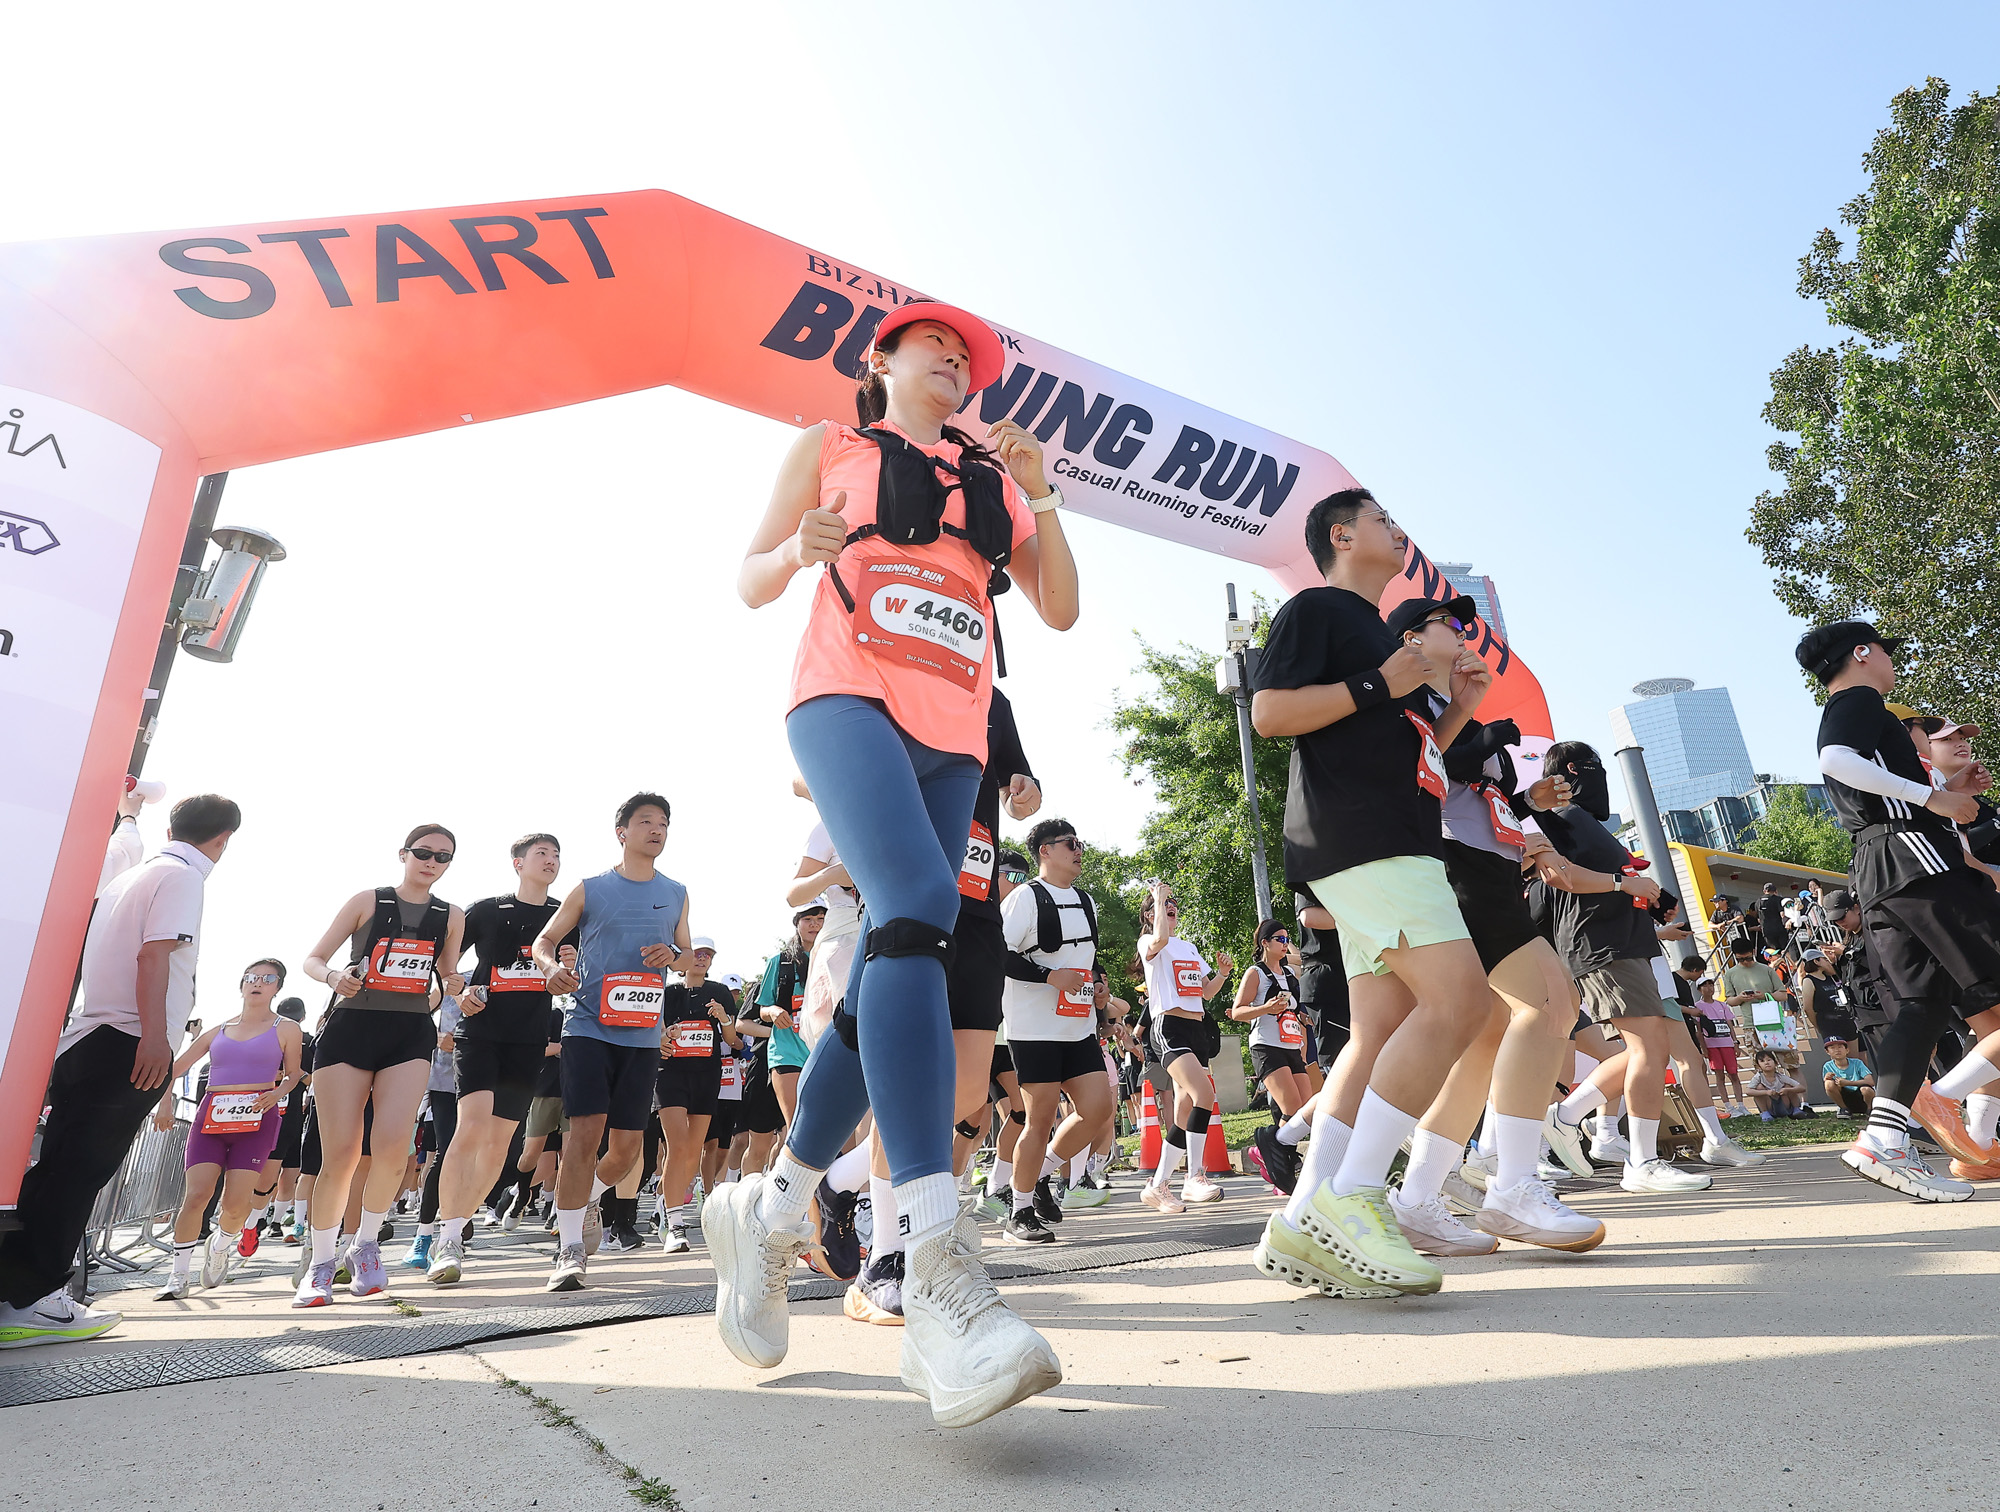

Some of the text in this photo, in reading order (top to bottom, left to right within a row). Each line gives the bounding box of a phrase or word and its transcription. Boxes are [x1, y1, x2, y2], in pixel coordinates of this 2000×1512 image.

[158, 207, 616, 319] START
[1155, 424, 1300, 518] RUN
[1053, 457, 1268, 537] Casual Running Festival
[867, 563, 946, 584] BURNING RUN
[885, 596, 909, 614] W
[914, 600, 984, 641] 4460
[870, 637, 895, 647] Bag Drop
[908, 622, 960, 649] SONG ANNA
[614, 991, 662, 1004] M 2087
[689, 1033, 713, 1041] 4535
